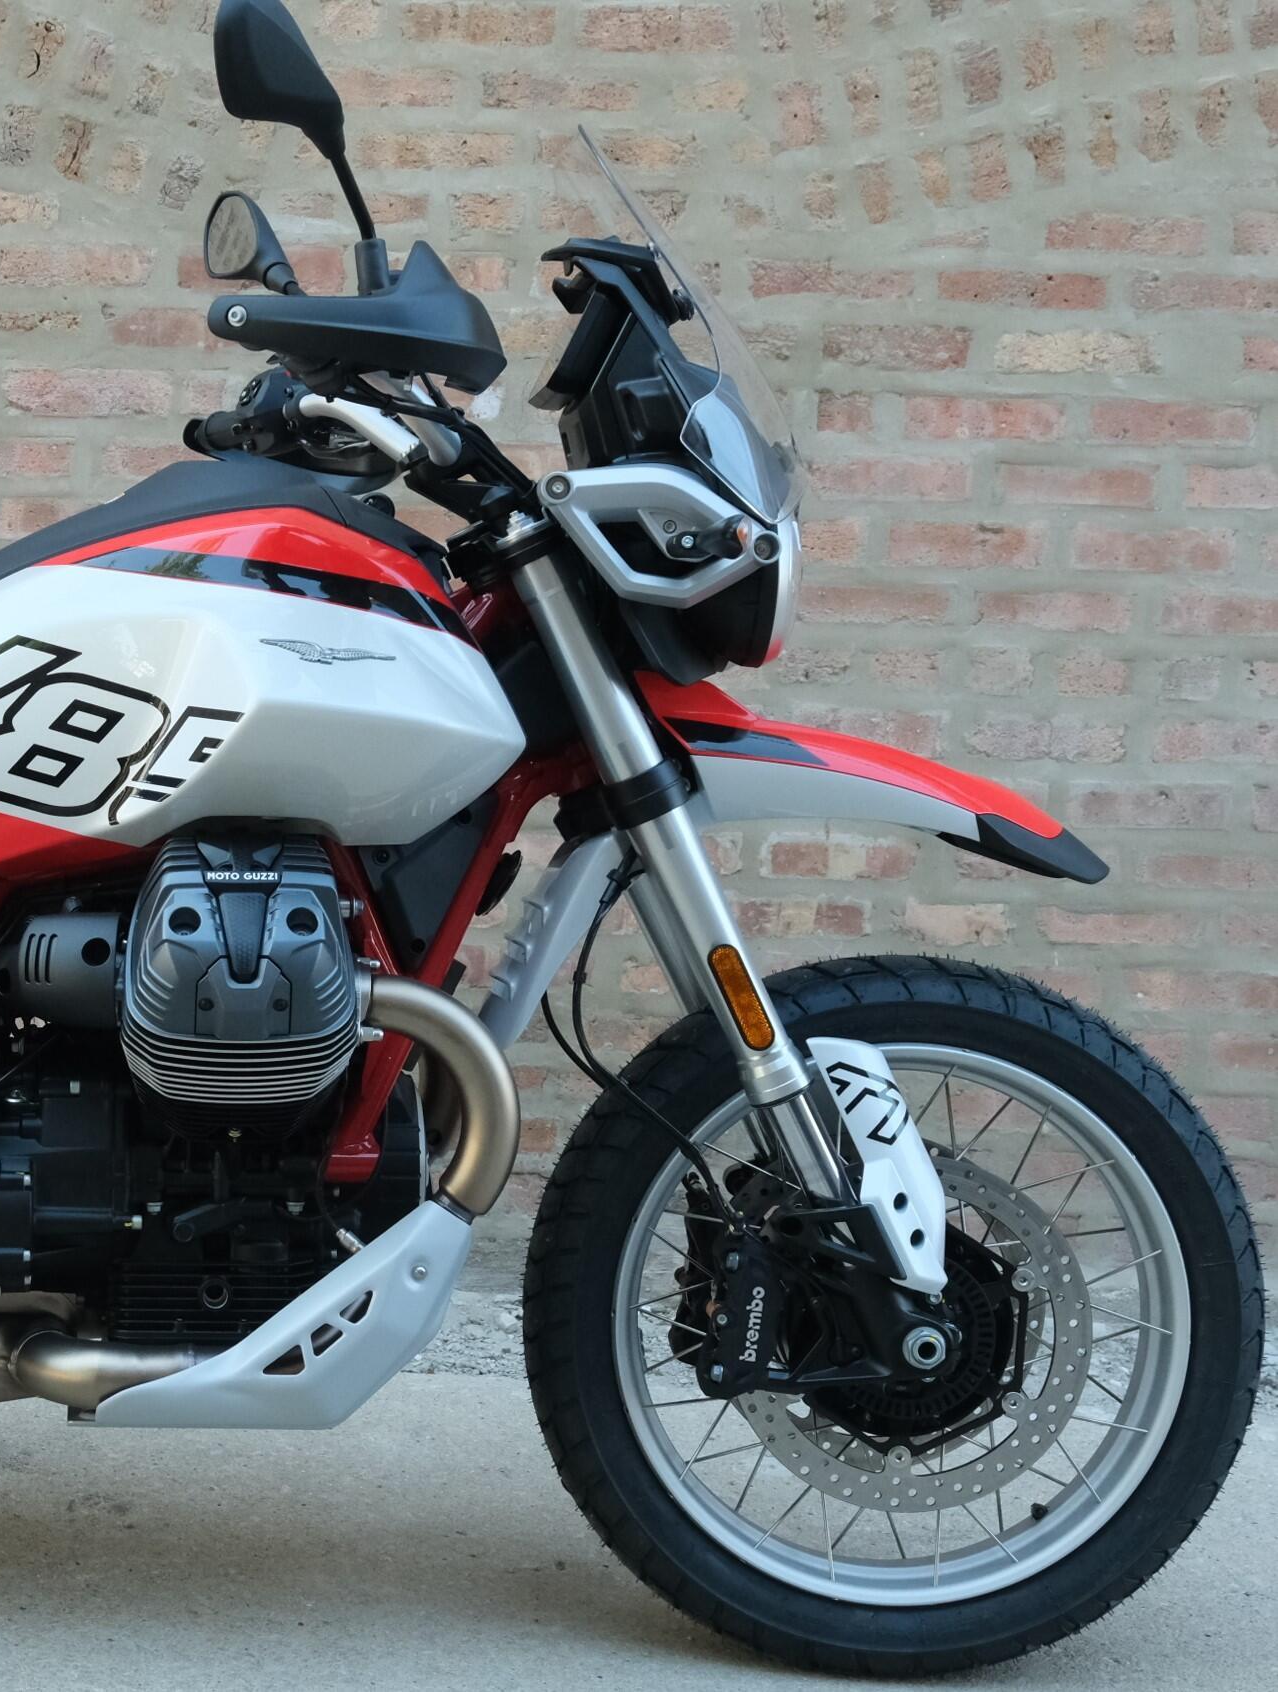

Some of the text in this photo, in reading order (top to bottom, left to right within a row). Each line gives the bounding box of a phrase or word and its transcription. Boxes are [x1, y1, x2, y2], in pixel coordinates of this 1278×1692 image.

[207, 872, 278, 880] MOTO GUZZI
[738, 1287, 765, 1362] brembo
